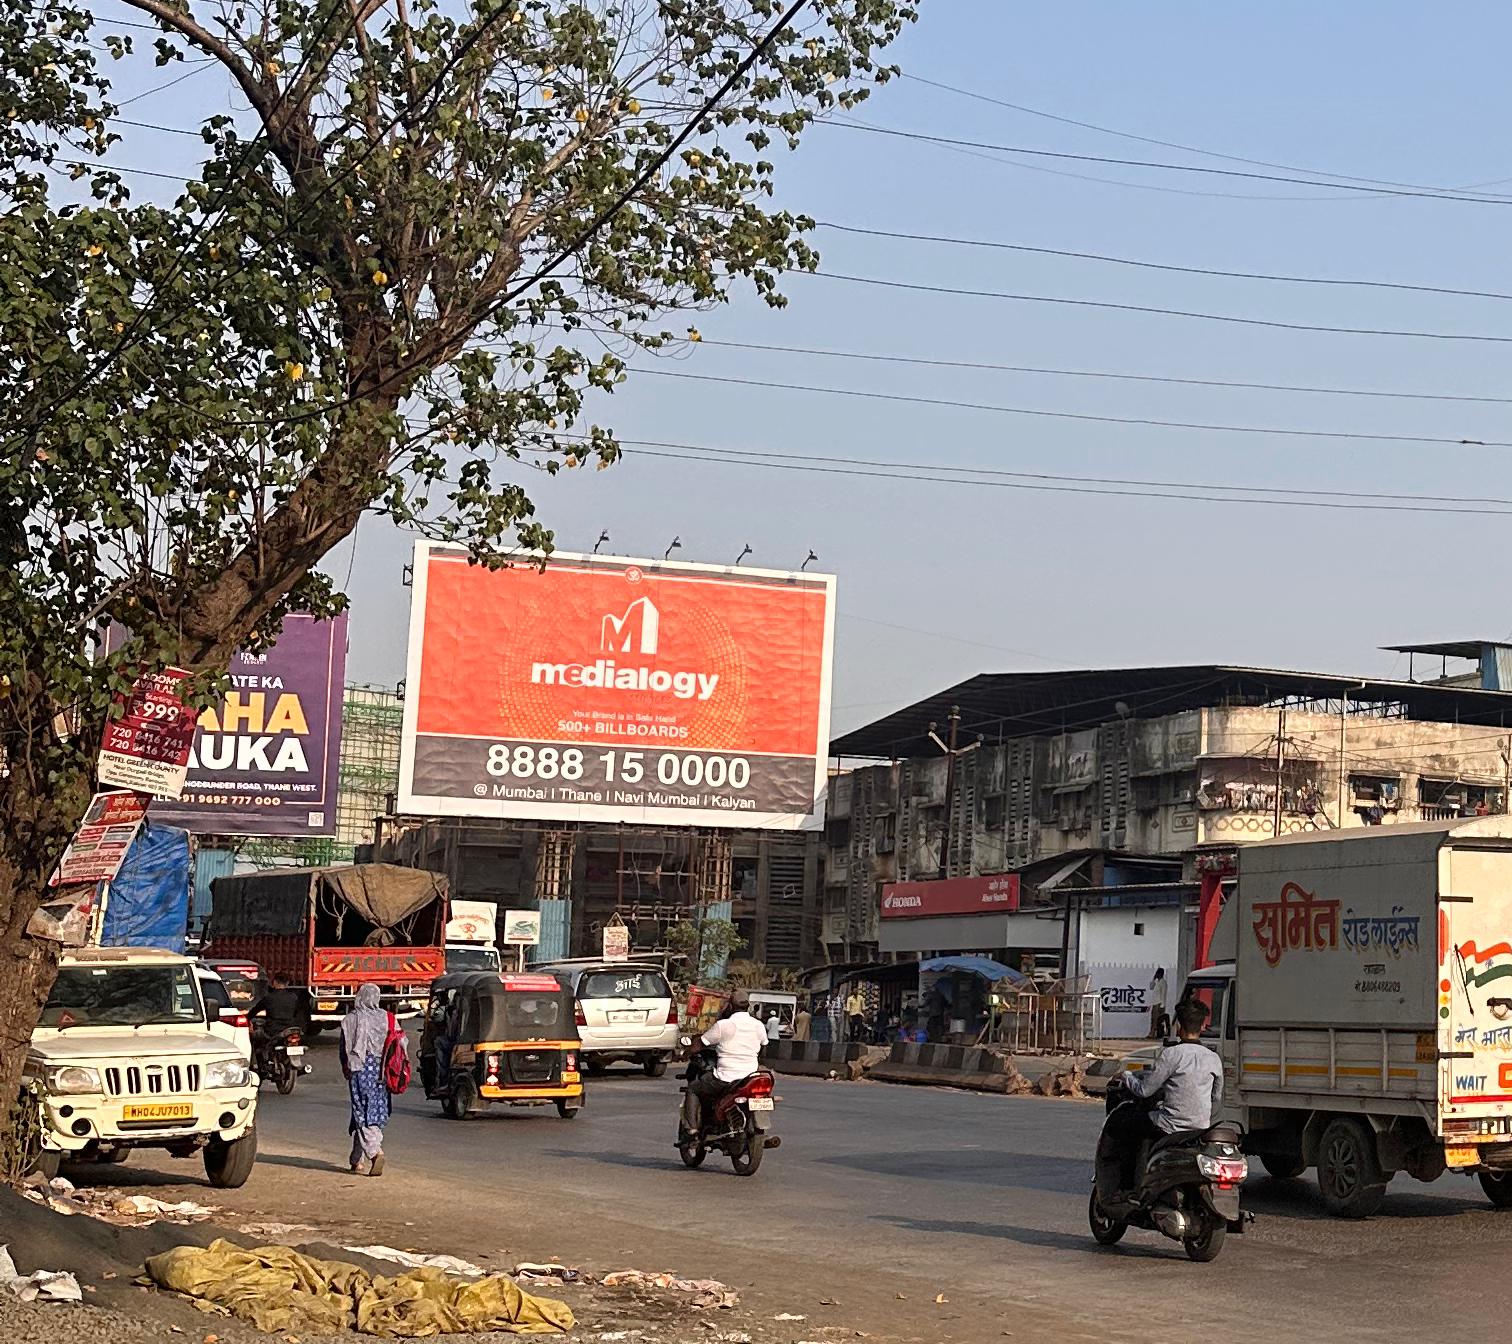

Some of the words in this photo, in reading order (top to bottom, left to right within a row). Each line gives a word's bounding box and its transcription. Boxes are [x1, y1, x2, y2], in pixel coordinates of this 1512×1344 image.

[262, 676, 284, 689] KA
[531, 659, 720, 701] medialogy
[197, 690, 309, 735] AHA
[573, 710, 591, 719] Your
[113, 726, 133, 738] 720
[163, 737, 183, 749] 741
[557, 721, 592, 733] 500+
[595, 722, 688, 739] BILLBOARDS
[109, 737, 130, 751] 720
[161, 747, 182, 760] 742
[187, 734, 309, 773] UKA
[486, 743, 584, 781] 8888
[599, 751, 644, 783] 15
[657, 753, 751, 789] 0000
[263, 783, 291, 792] THANE
[473, 784, 489, 797] @
[492, 785, 547, 801] Mumbai
[559, 788, 602, 802] Thane
[614, 790, 643, 805] Navi
[646, 791, 700, 807] Mumbai
[711, 795, 756, 811] Kalyan
[198, 795, 228, 804] 9692
[231, 795, 252, 805] 777
[255, 797, 281, 806] 000
[892, 896, 922, 908] HONDA
[1252, 881, 1341, 968] सुमित
[1111, 985, 1146, 1006] आहेर
[1481, 1026, 1512, 1048] भारत
[1456, 1075, 1487, 1091] WAIT
[131, 1106, 190, 1117] MH04JU7013
